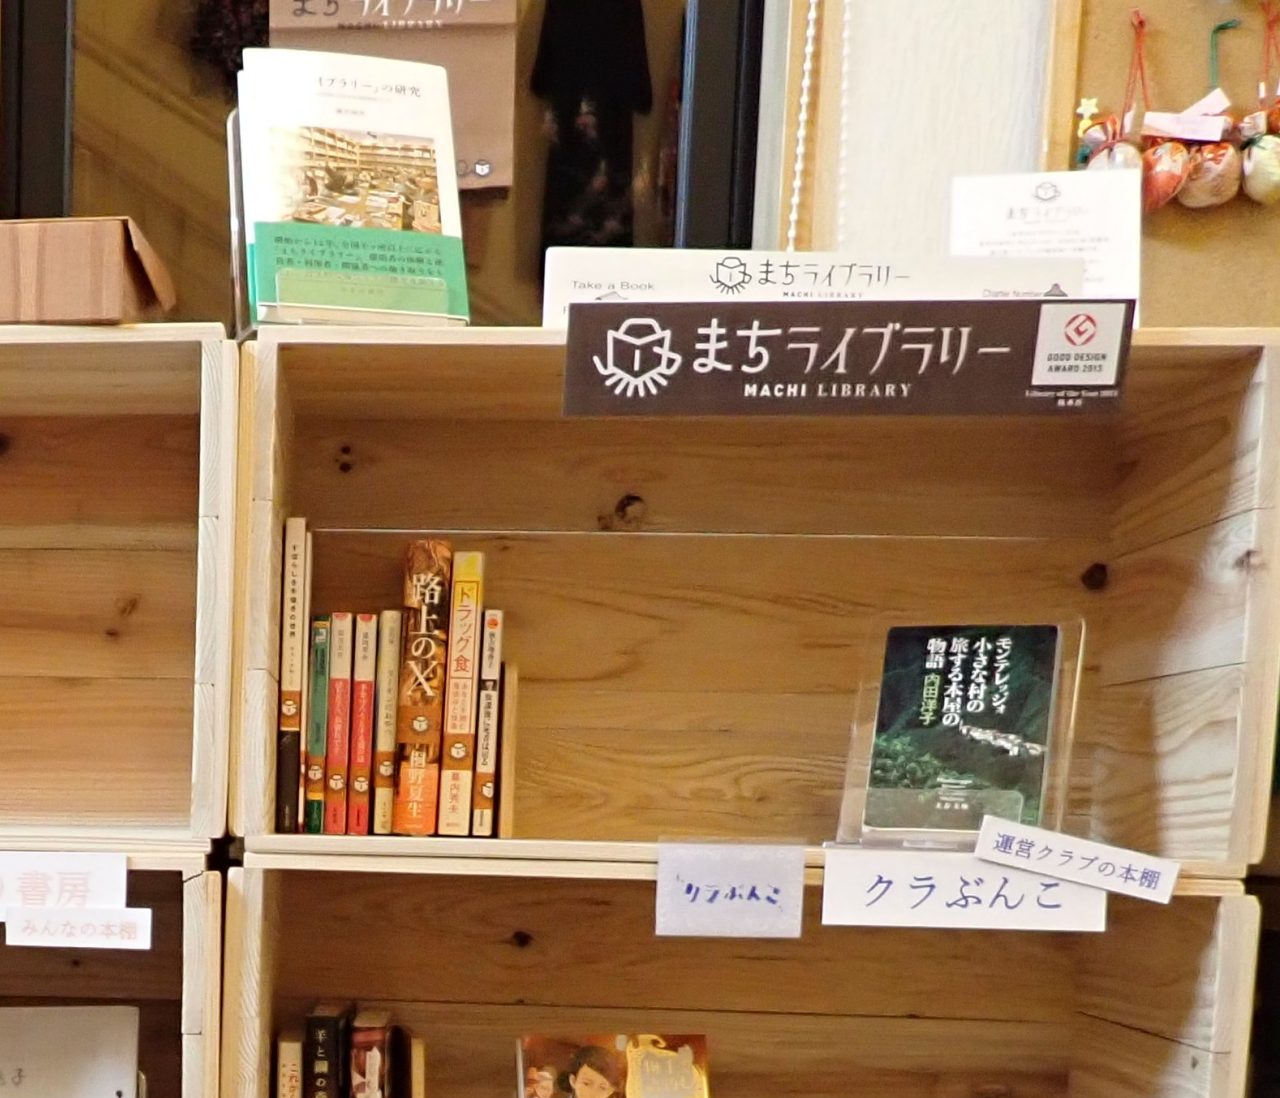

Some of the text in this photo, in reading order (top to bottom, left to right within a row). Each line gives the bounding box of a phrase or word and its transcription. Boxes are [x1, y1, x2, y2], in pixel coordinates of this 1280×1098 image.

[572, 281, 655, 290] Take a Book
[757, 258, 911, 286] まちライブラリー
[692, 317, 1011, 376] まちライブラリー
[1047, 353, 1108, 362] GOOD DESIGN
[1047, 364, 1080, 373] AWARD
[744, 383, 913, 398] MACHI LIBRARY
[407, 573, 443, 697] 路上のX
[452, 585, 473, 673] ドラッグ食
[925, 638, 946, 669] 物語
[942, 637, 969, 726] 旅する本屋の
[966, 637, 993, 713] 小さな村の
[919, 673, 940, 726] 内田洋子
[992, 831, 1162, 892] 運営クラブの本棚
[864, 874, 1063, 911] クラぶんこ
[21, 919, 138, 941] みんなの本棚
